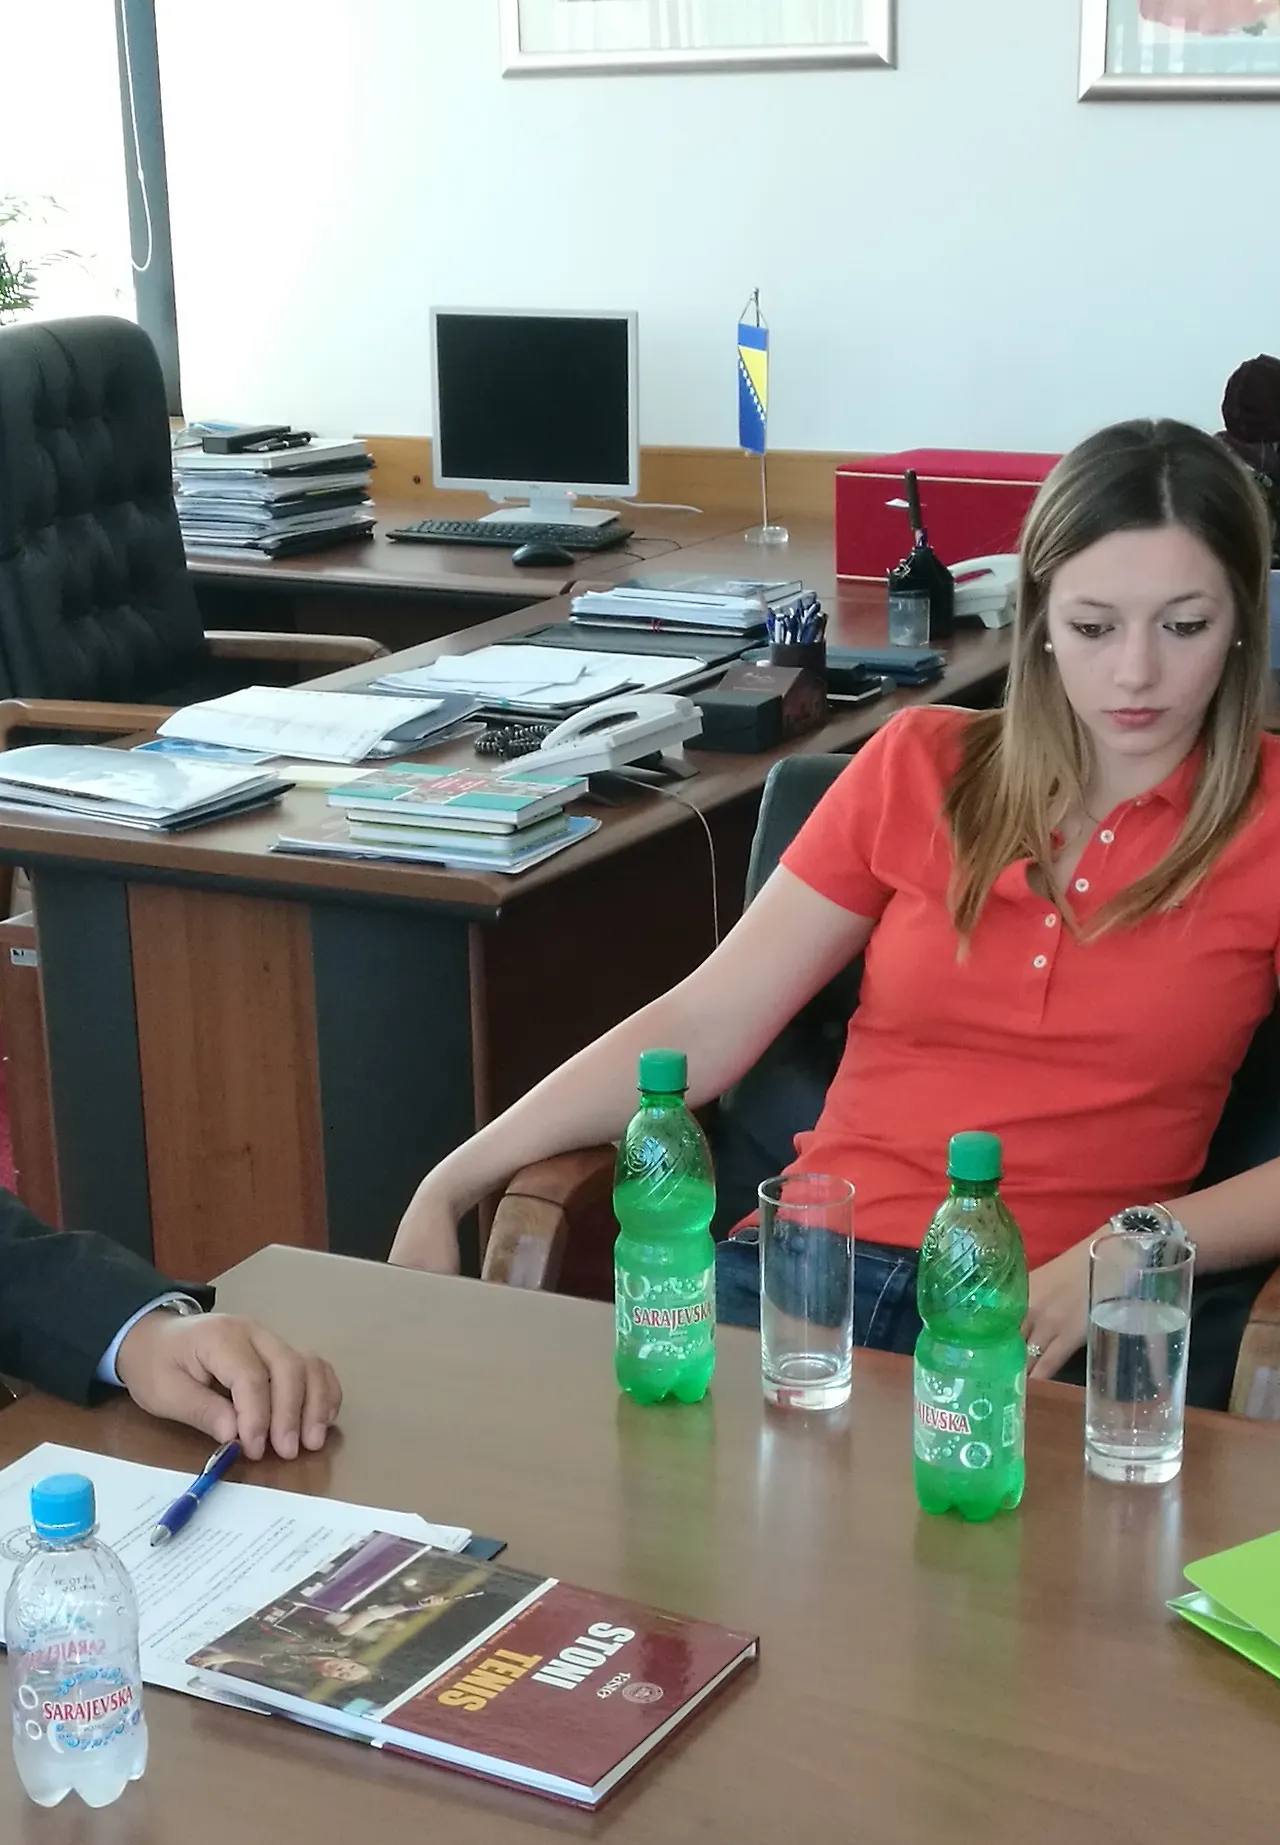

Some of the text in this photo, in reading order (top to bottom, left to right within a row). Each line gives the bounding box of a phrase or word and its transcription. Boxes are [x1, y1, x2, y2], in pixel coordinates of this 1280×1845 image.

[633, 1302, 713, 1331] SARAJEVSKA
[436, 1649, 544, 1712] TENIS
[531, 1622, 636, 1690] STONI
[43, 1686, 134, 1722] SARAJEVSKA
